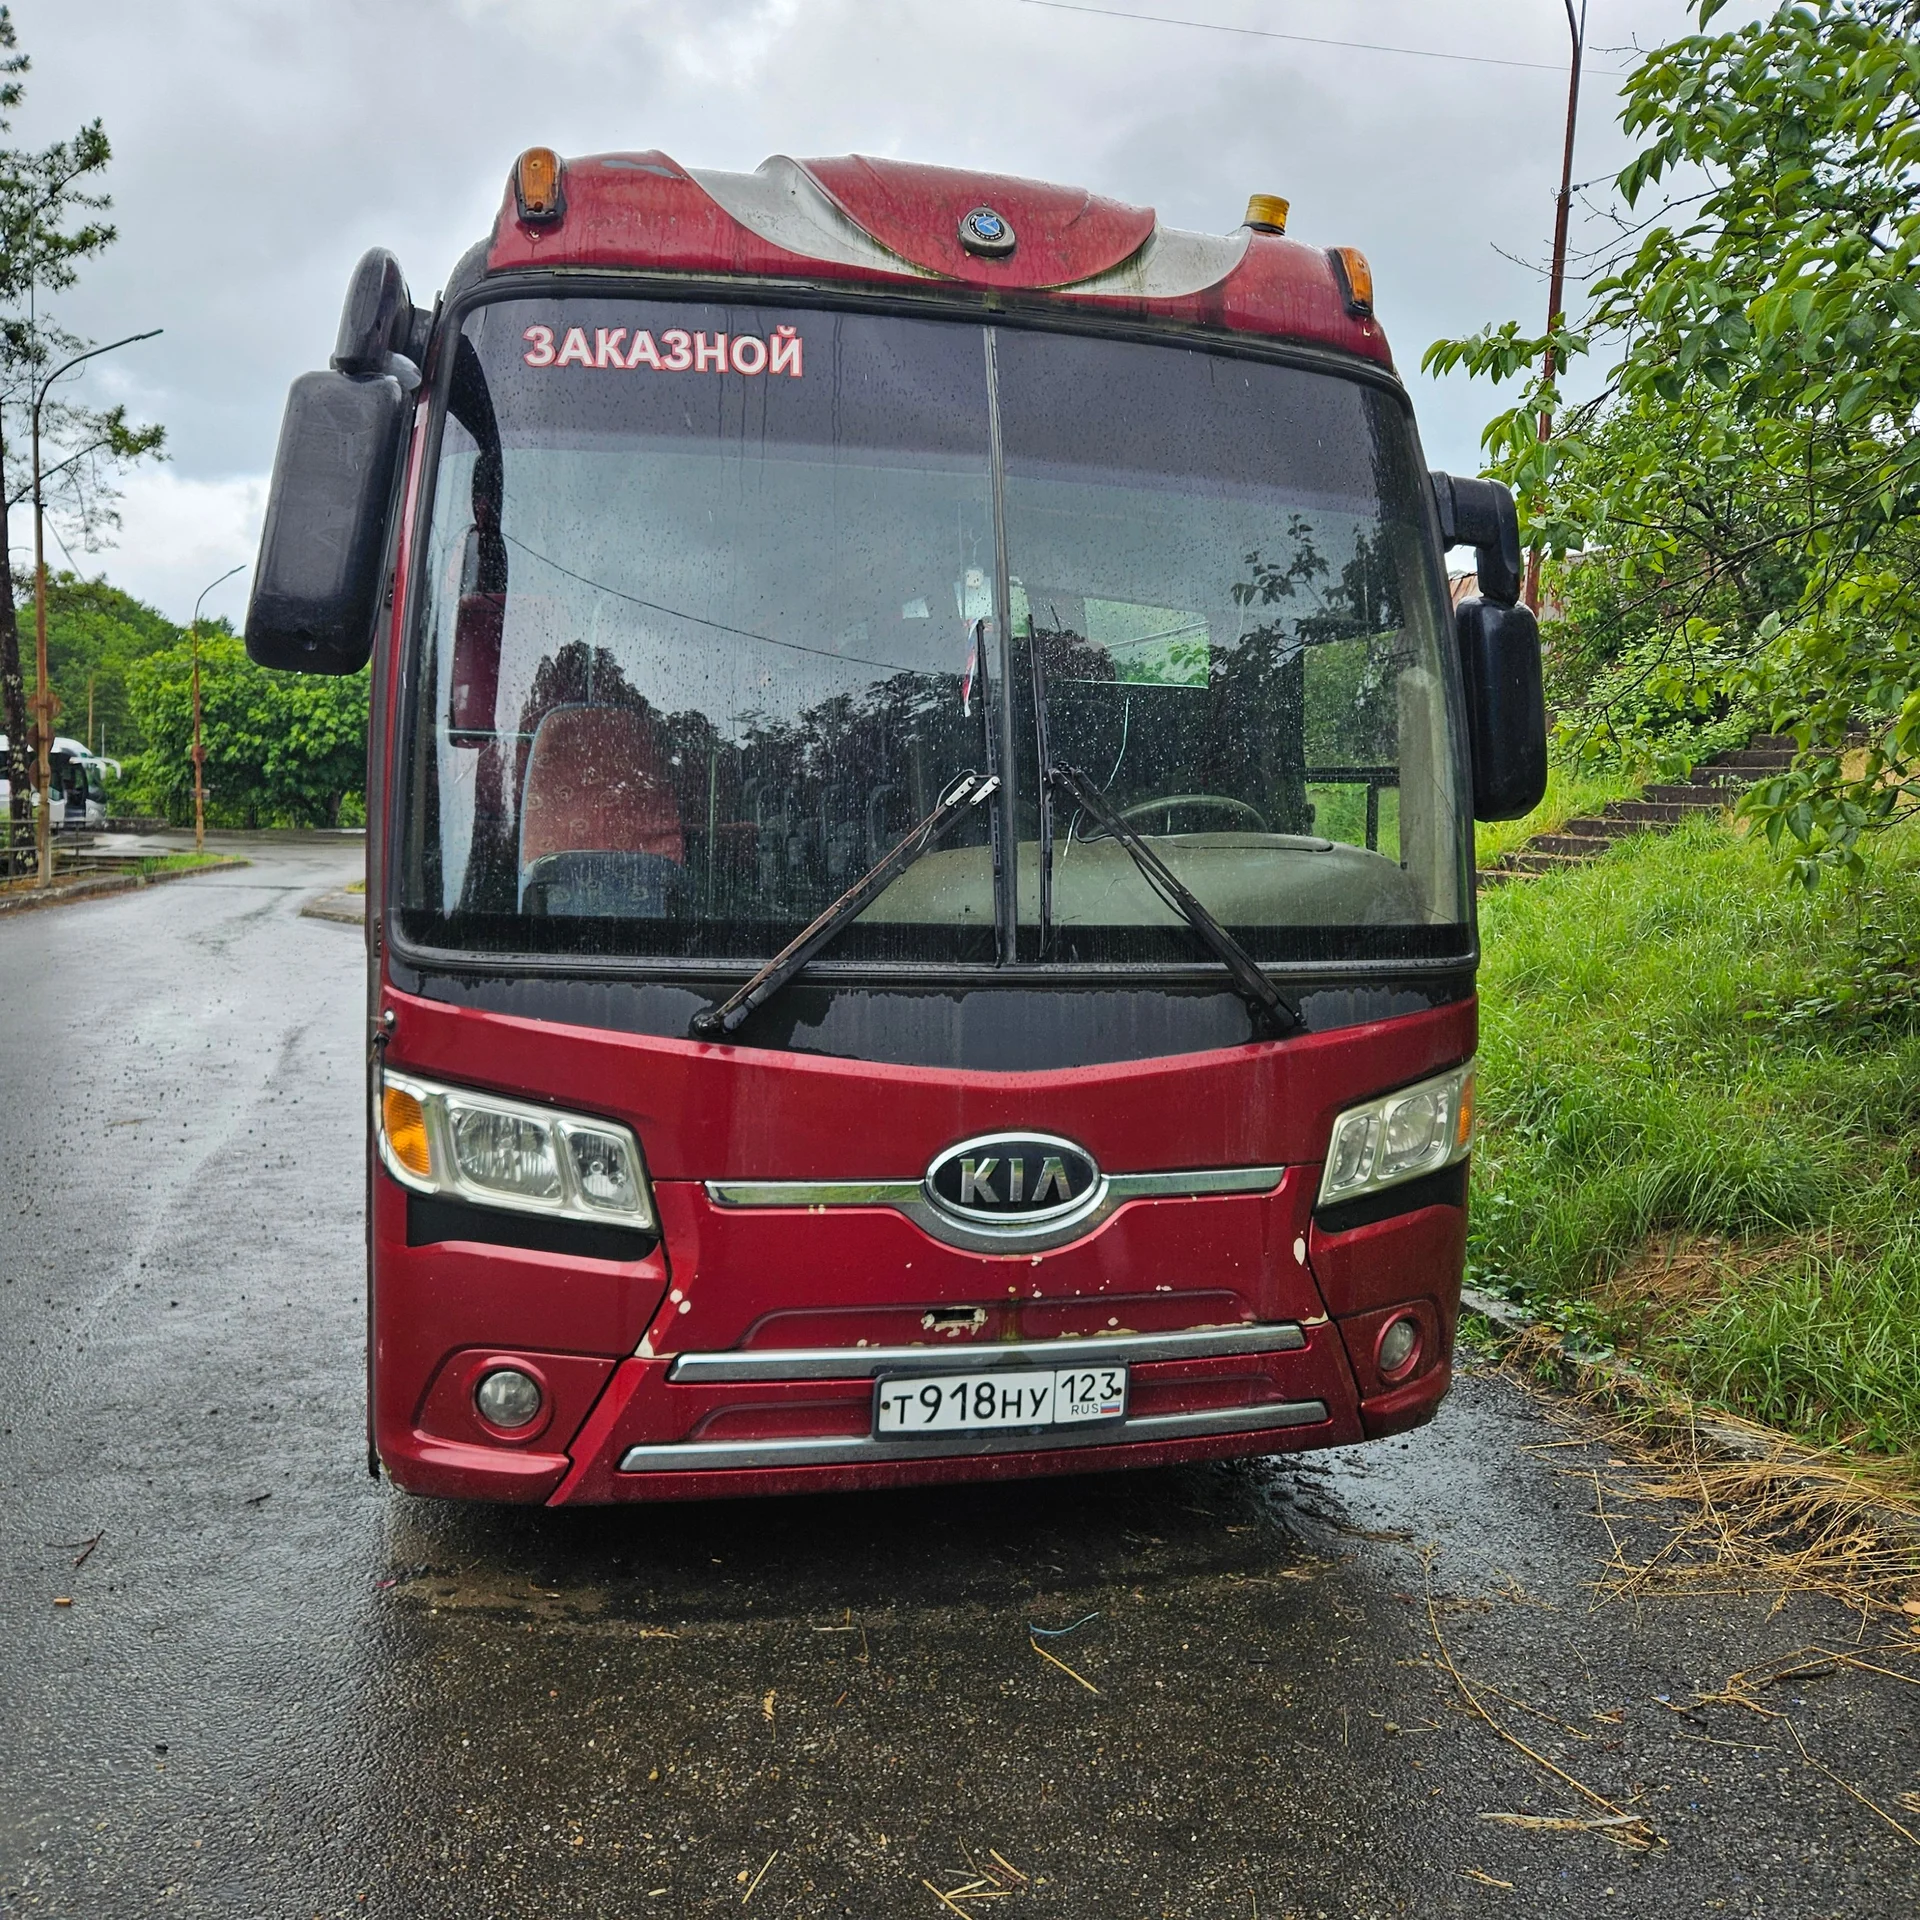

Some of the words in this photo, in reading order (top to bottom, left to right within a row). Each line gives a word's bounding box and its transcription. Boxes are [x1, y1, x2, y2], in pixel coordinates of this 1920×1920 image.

[523, 324, 803, 377] ЗАКАЗНОЙ
[959, 1156, 1073, 1203] KIA
[1061, 1372, 1116, 1403] 123
[1070, 1403, 1099, 1416] RUS
